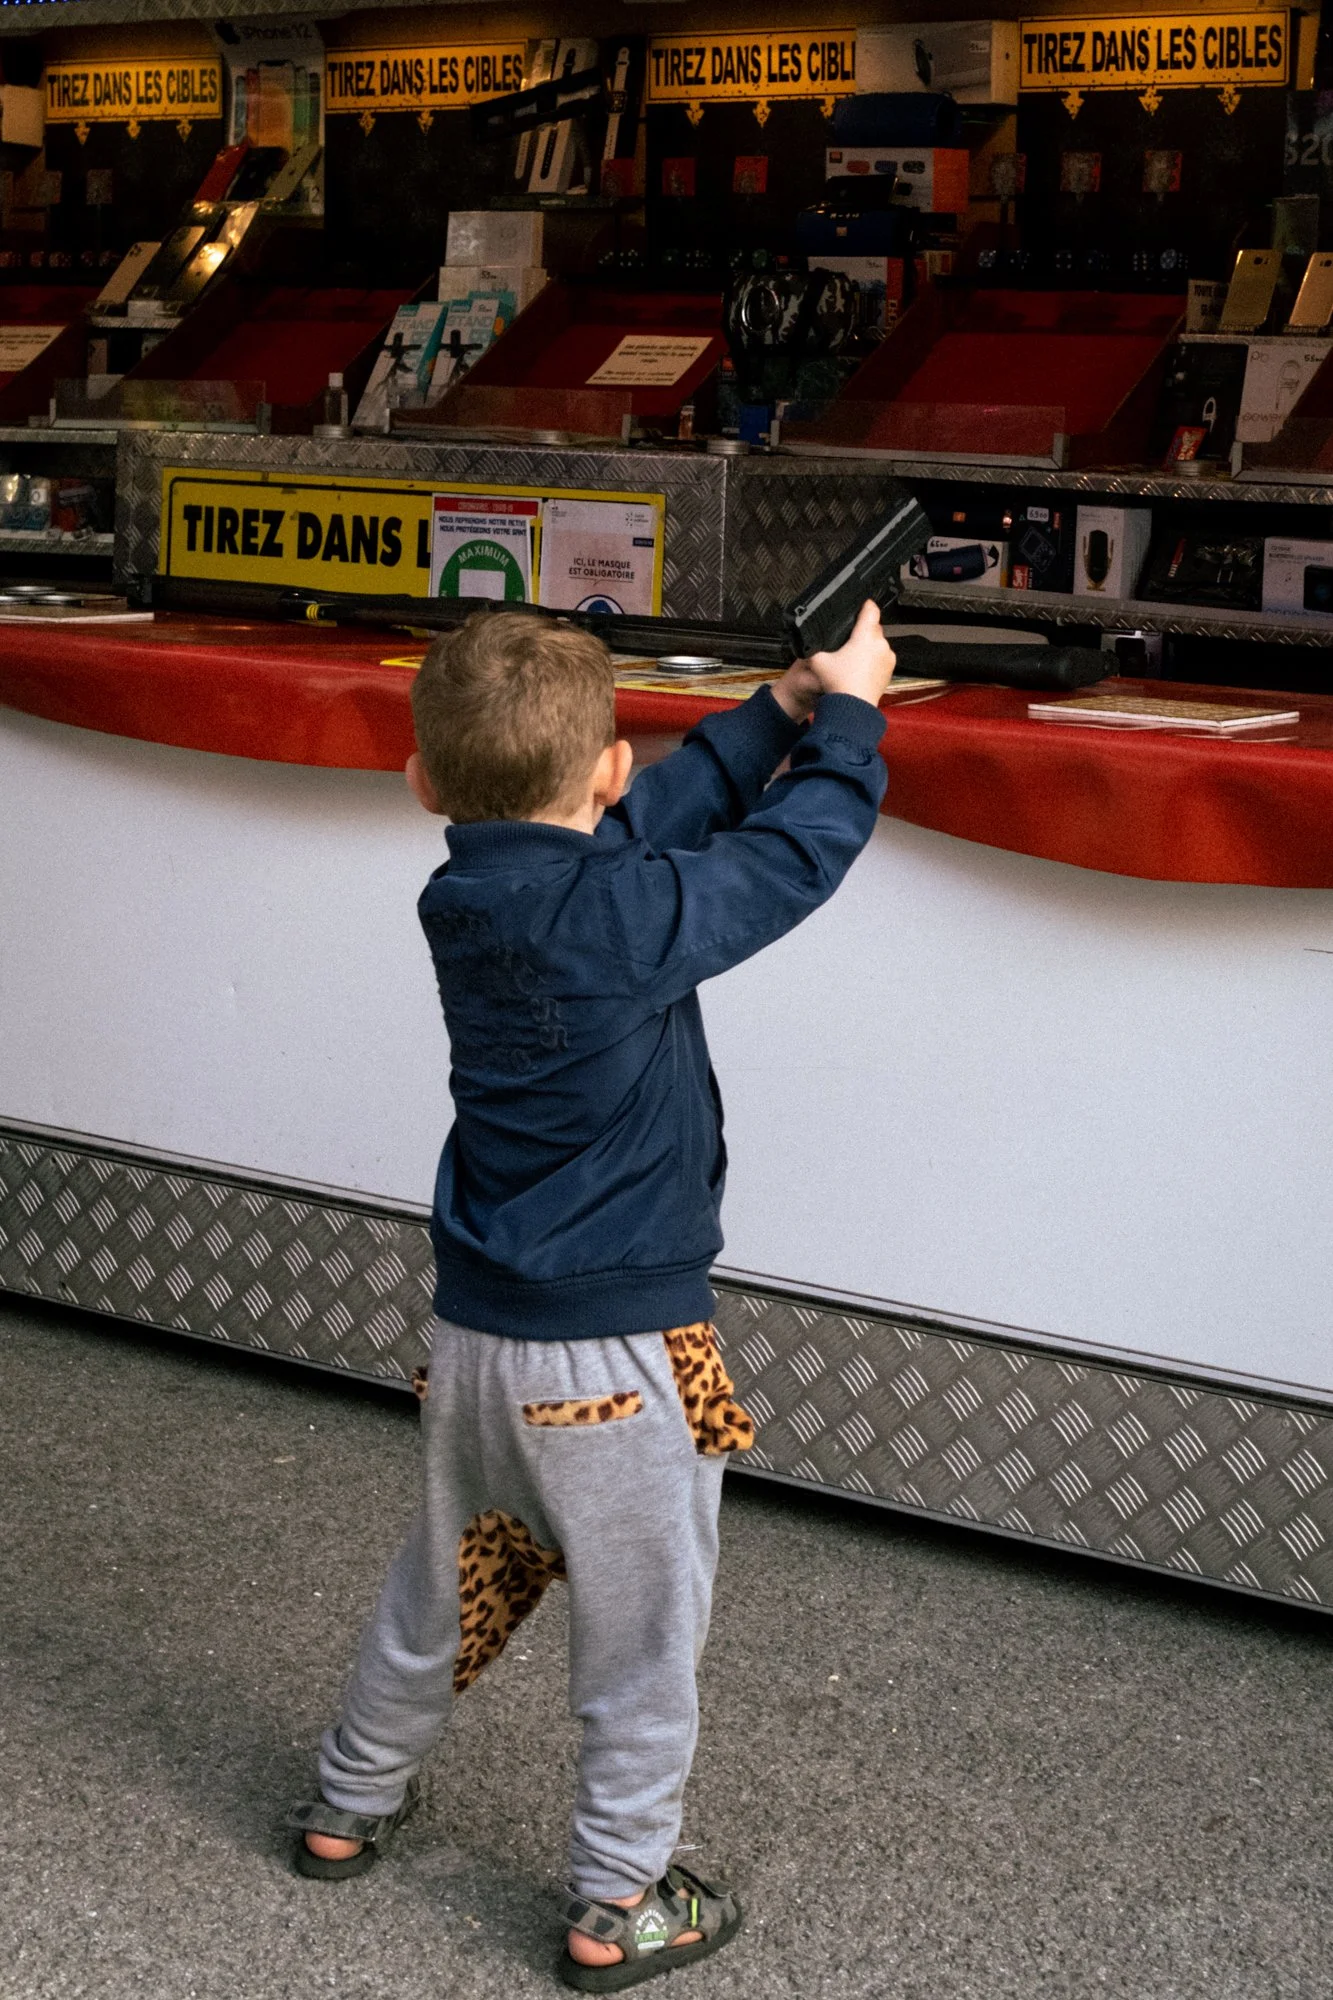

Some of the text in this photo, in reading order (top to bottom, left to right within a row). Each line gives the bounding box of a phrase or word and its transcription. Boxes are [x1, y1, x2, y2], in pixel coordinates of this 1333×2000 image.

[652, 41, 855, 86] TIREZ DANS LES CIBL
[1024, 24, 1282, 74] TIREZ DANS LES CIBLES
[47, 68, 217, 107] TIREZ DANS LES CIBLES
[328, 54, 522, 97] TIREZ DANS LES CIBLES
[183, 504, 286, 558] TIREZ
[297, 511, 403, 568] DANS
[440, 525, 455, 533] NOUS
[493, 527, 511, 536] VOTRE
[455, 517, 487, 525] REPRENONS
[489, 518, 507, 526] NOTRE
[458, 545, 510, 567] MAXIMUM
[573, 558, 631, 569] ICI, LE MASQUE
[568, 567, 635, 580] EST OBLIGATOIRE
